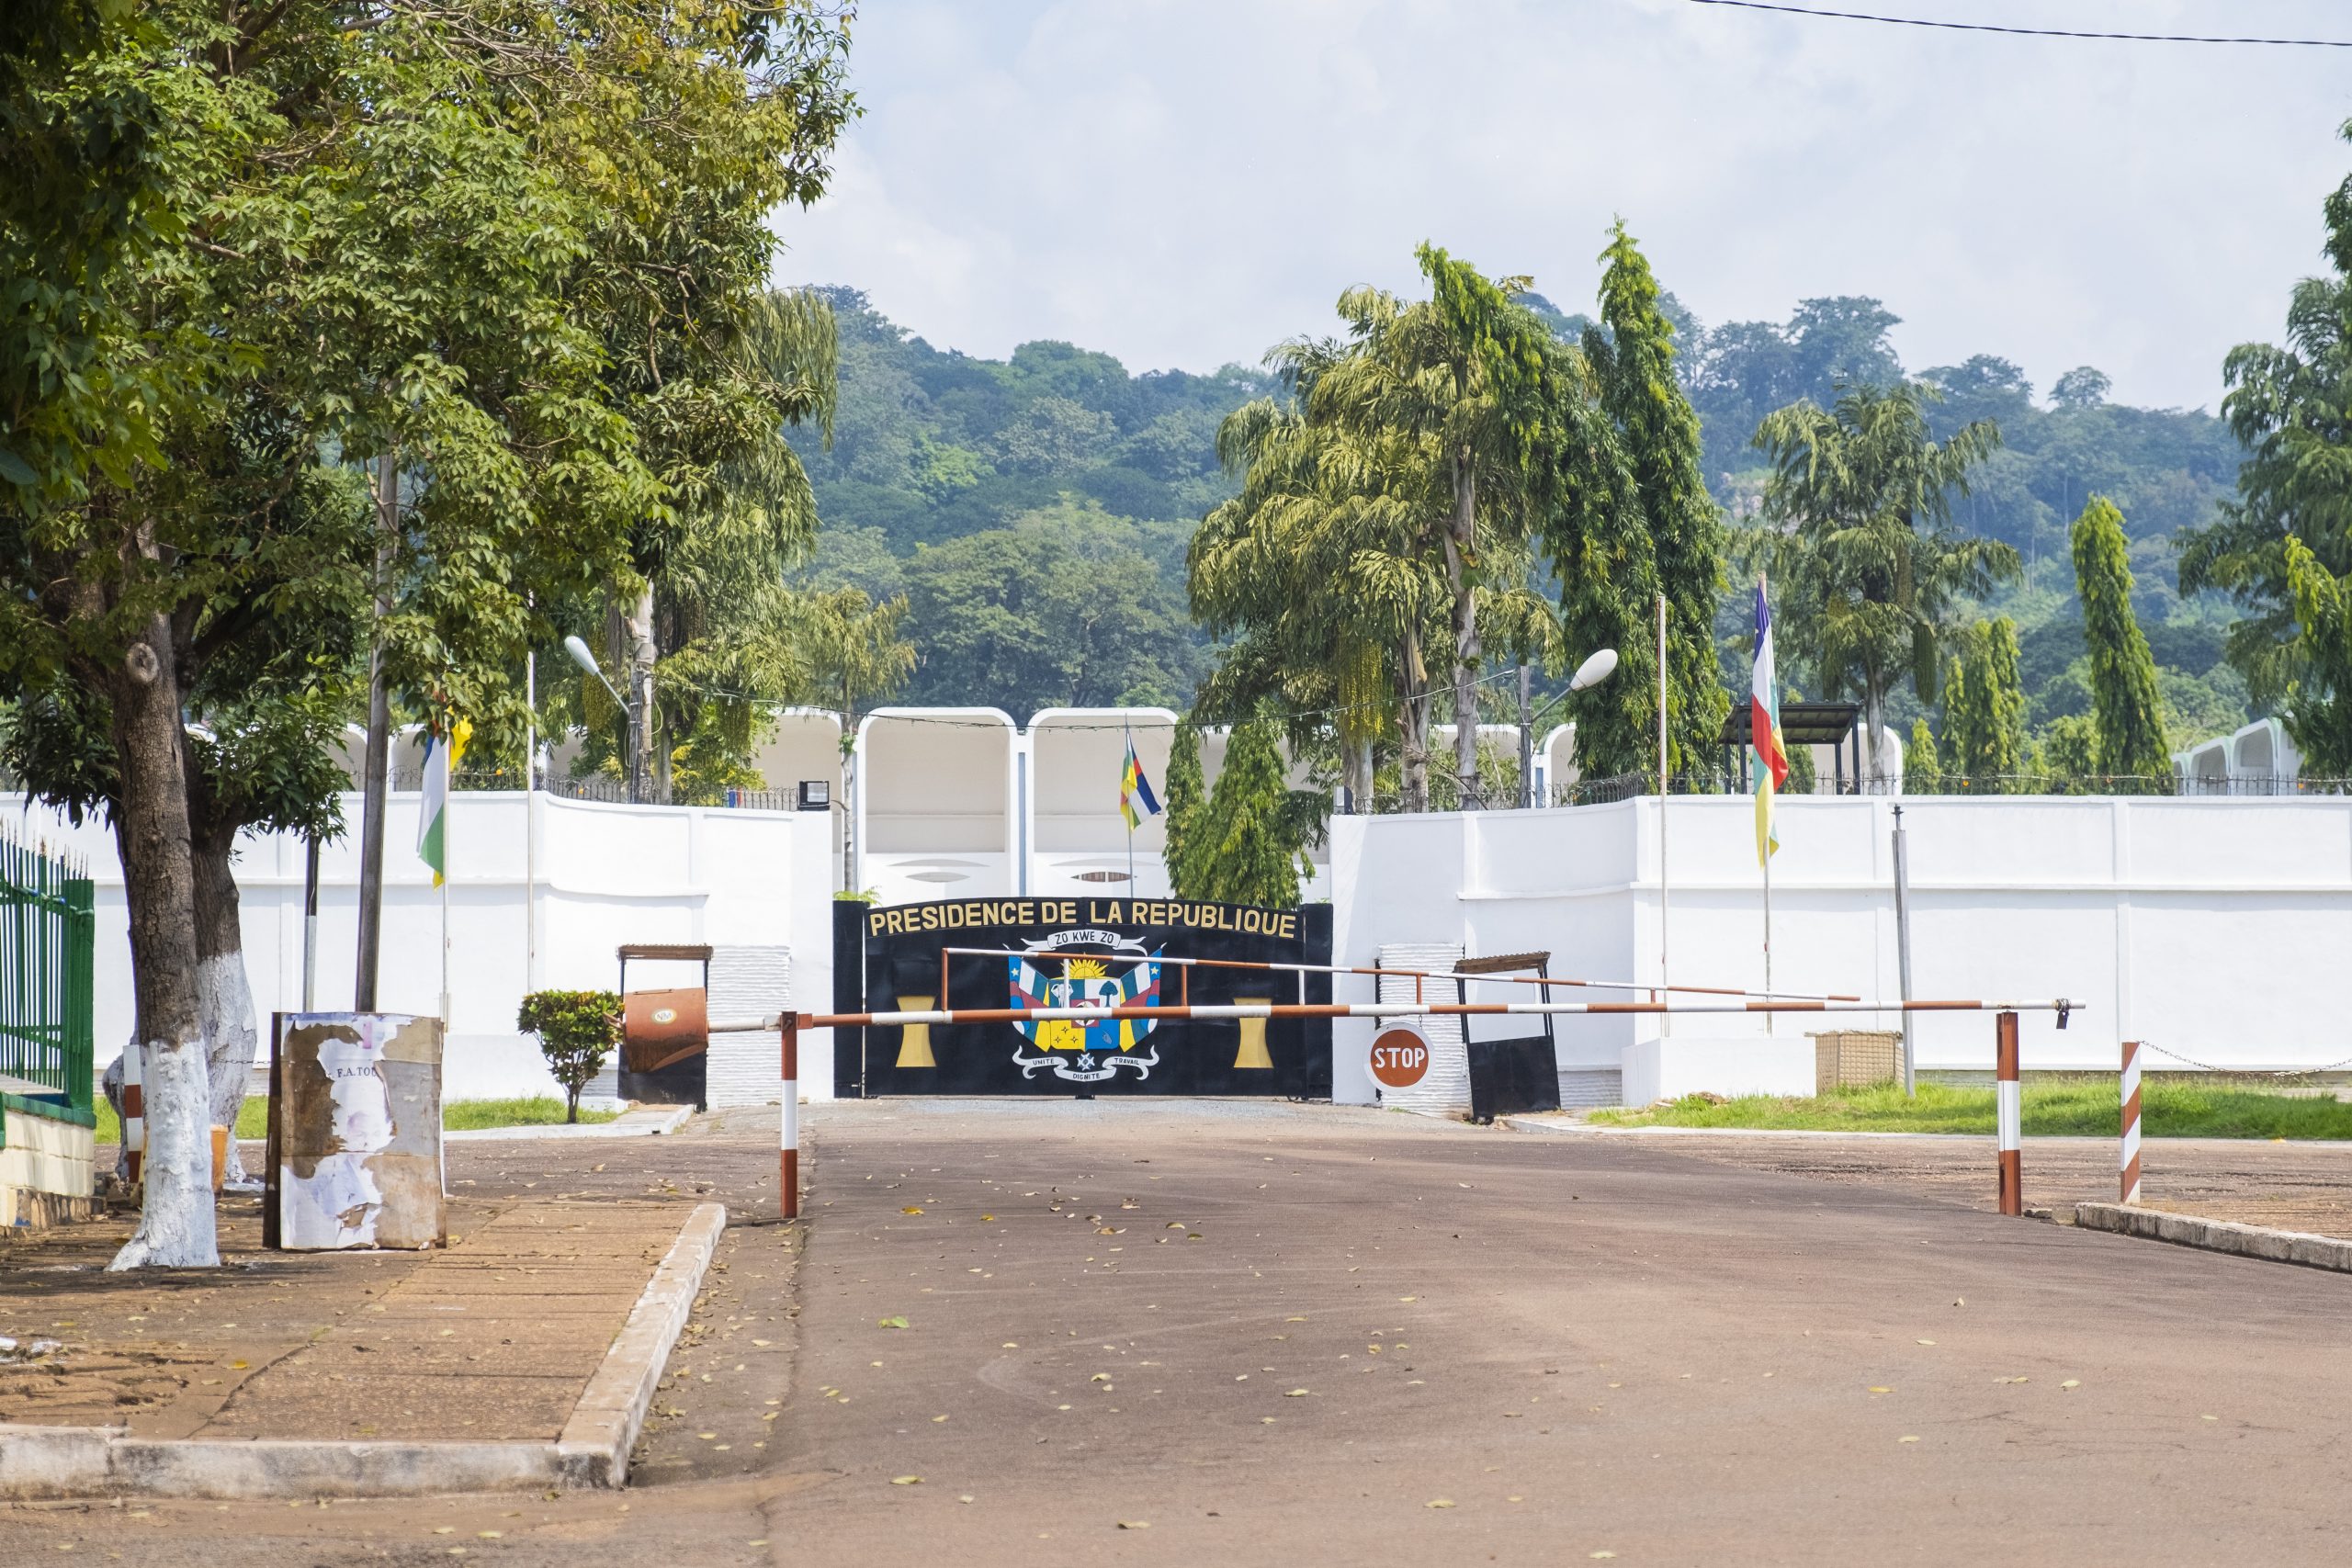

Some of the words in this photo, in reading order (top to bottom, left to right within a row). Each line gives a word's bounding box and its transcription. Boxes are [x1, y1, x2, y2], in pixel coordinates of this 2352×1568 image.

[870, 902, 1035, 937] PRESIDENCE
[1041, 901, 1077, 924] DE
[1091, 901, 1123, 924] LA
[1132, 901, 1296, 939] REPUBLIQUE
[1055, 932, 1069, 945] ZO
[1072, 931, 1095, 942] KWE
[1100, 931, 1114, 944] ZO
[1032, 1057, 1055, 1066] UNITE
[1114, 1057, 1140, 1066] TRAVAIL
[1374, 1047, 1425, 1069] STOP
